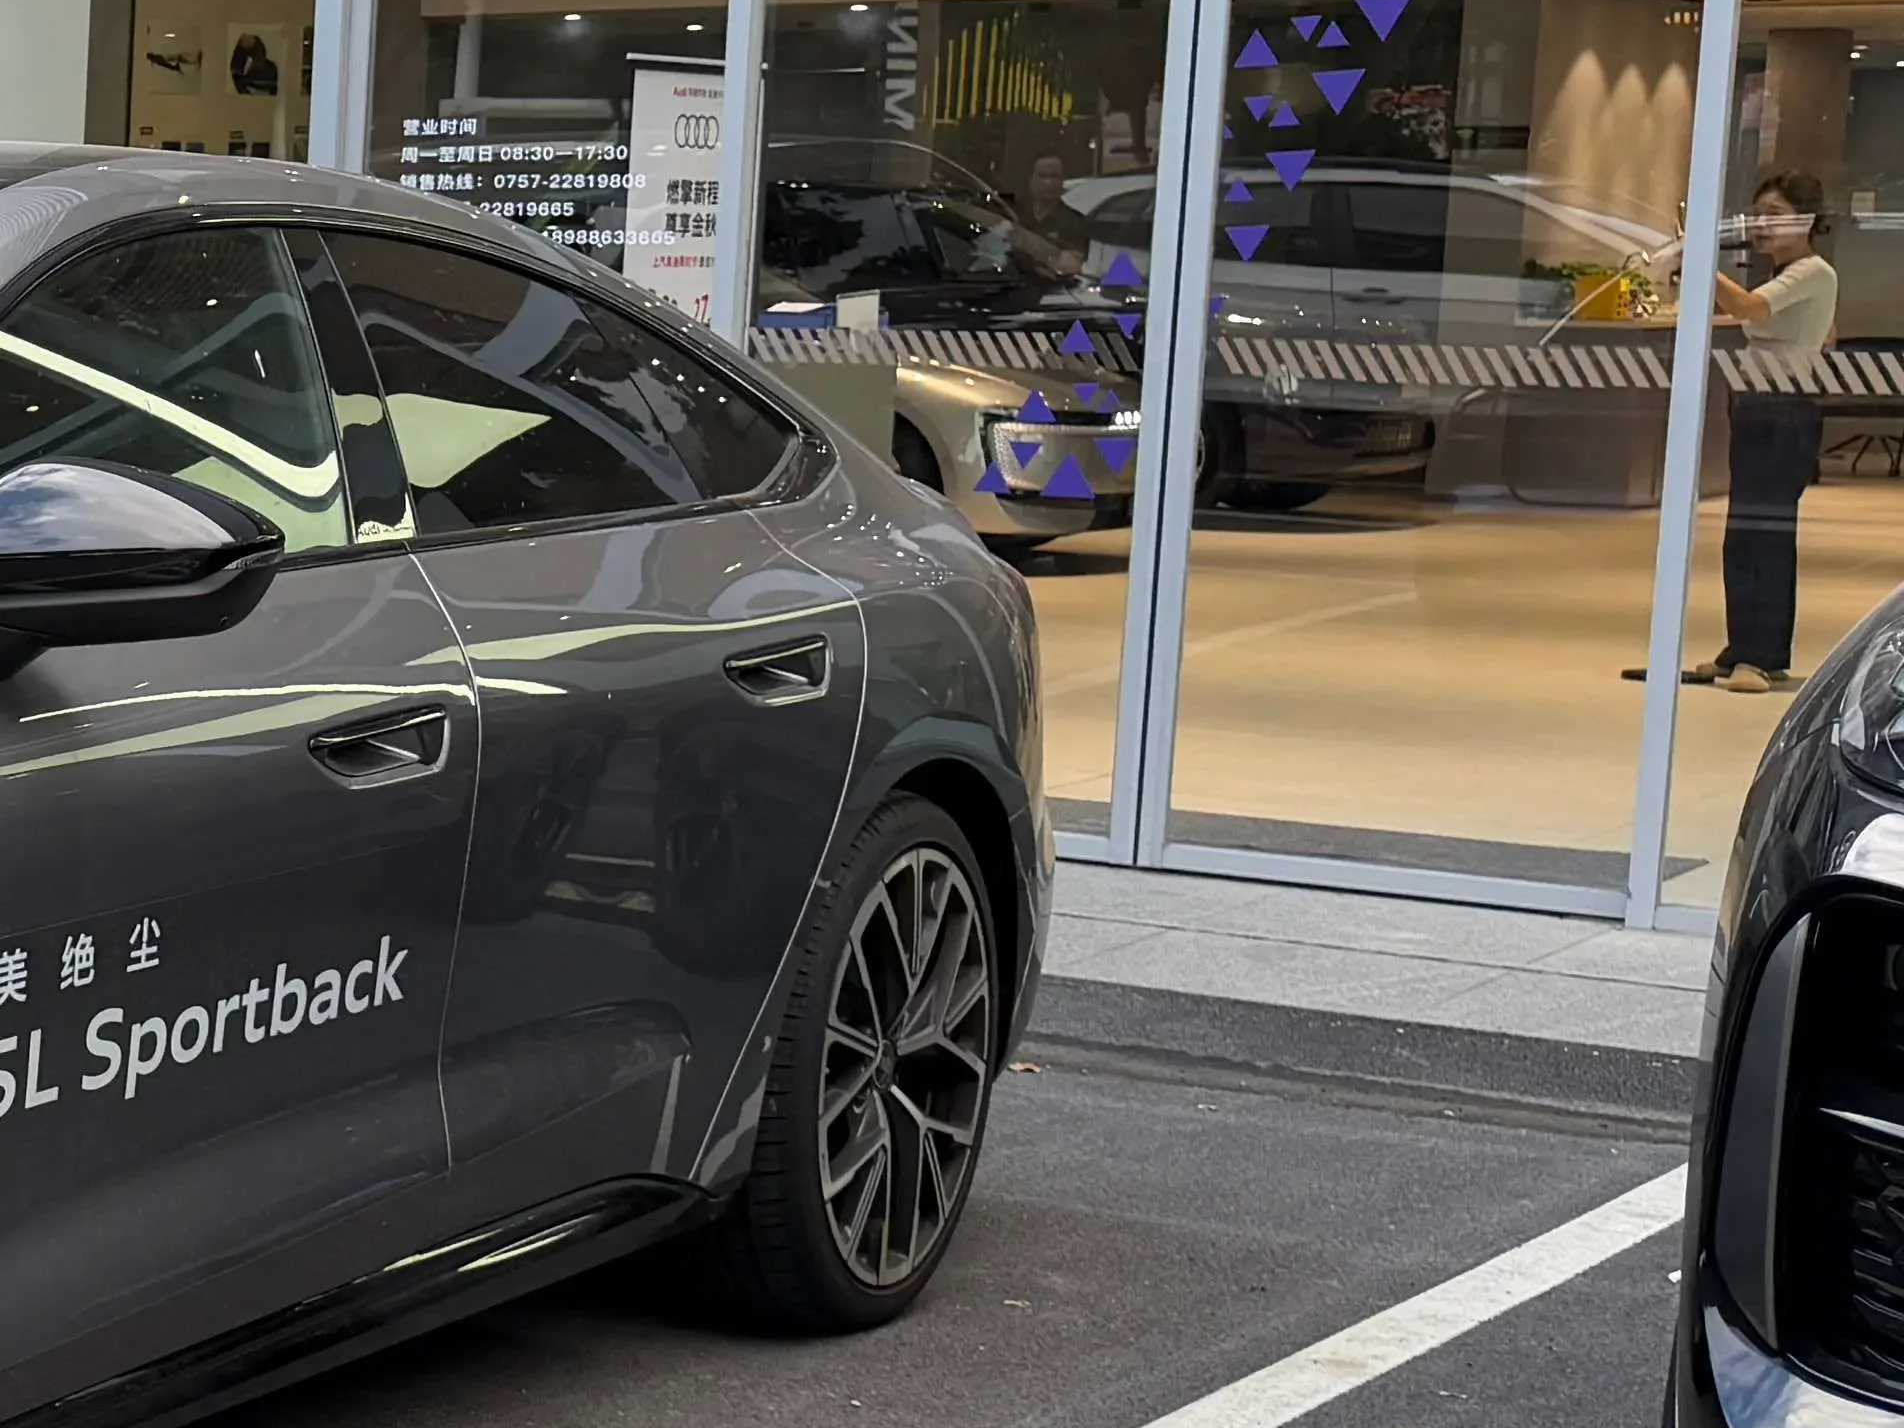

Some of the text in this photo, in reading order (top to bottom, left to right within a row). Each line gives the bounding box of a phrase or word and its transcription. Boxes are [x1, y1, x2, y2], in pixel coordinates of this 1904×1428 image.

[402, 118, 478, 137] 营业时间
[399, 145, 493, 164] 周一至周日
[493, 173, 647, 190] 0757-22819808
[80, 935, 409, 1100] Sportback
